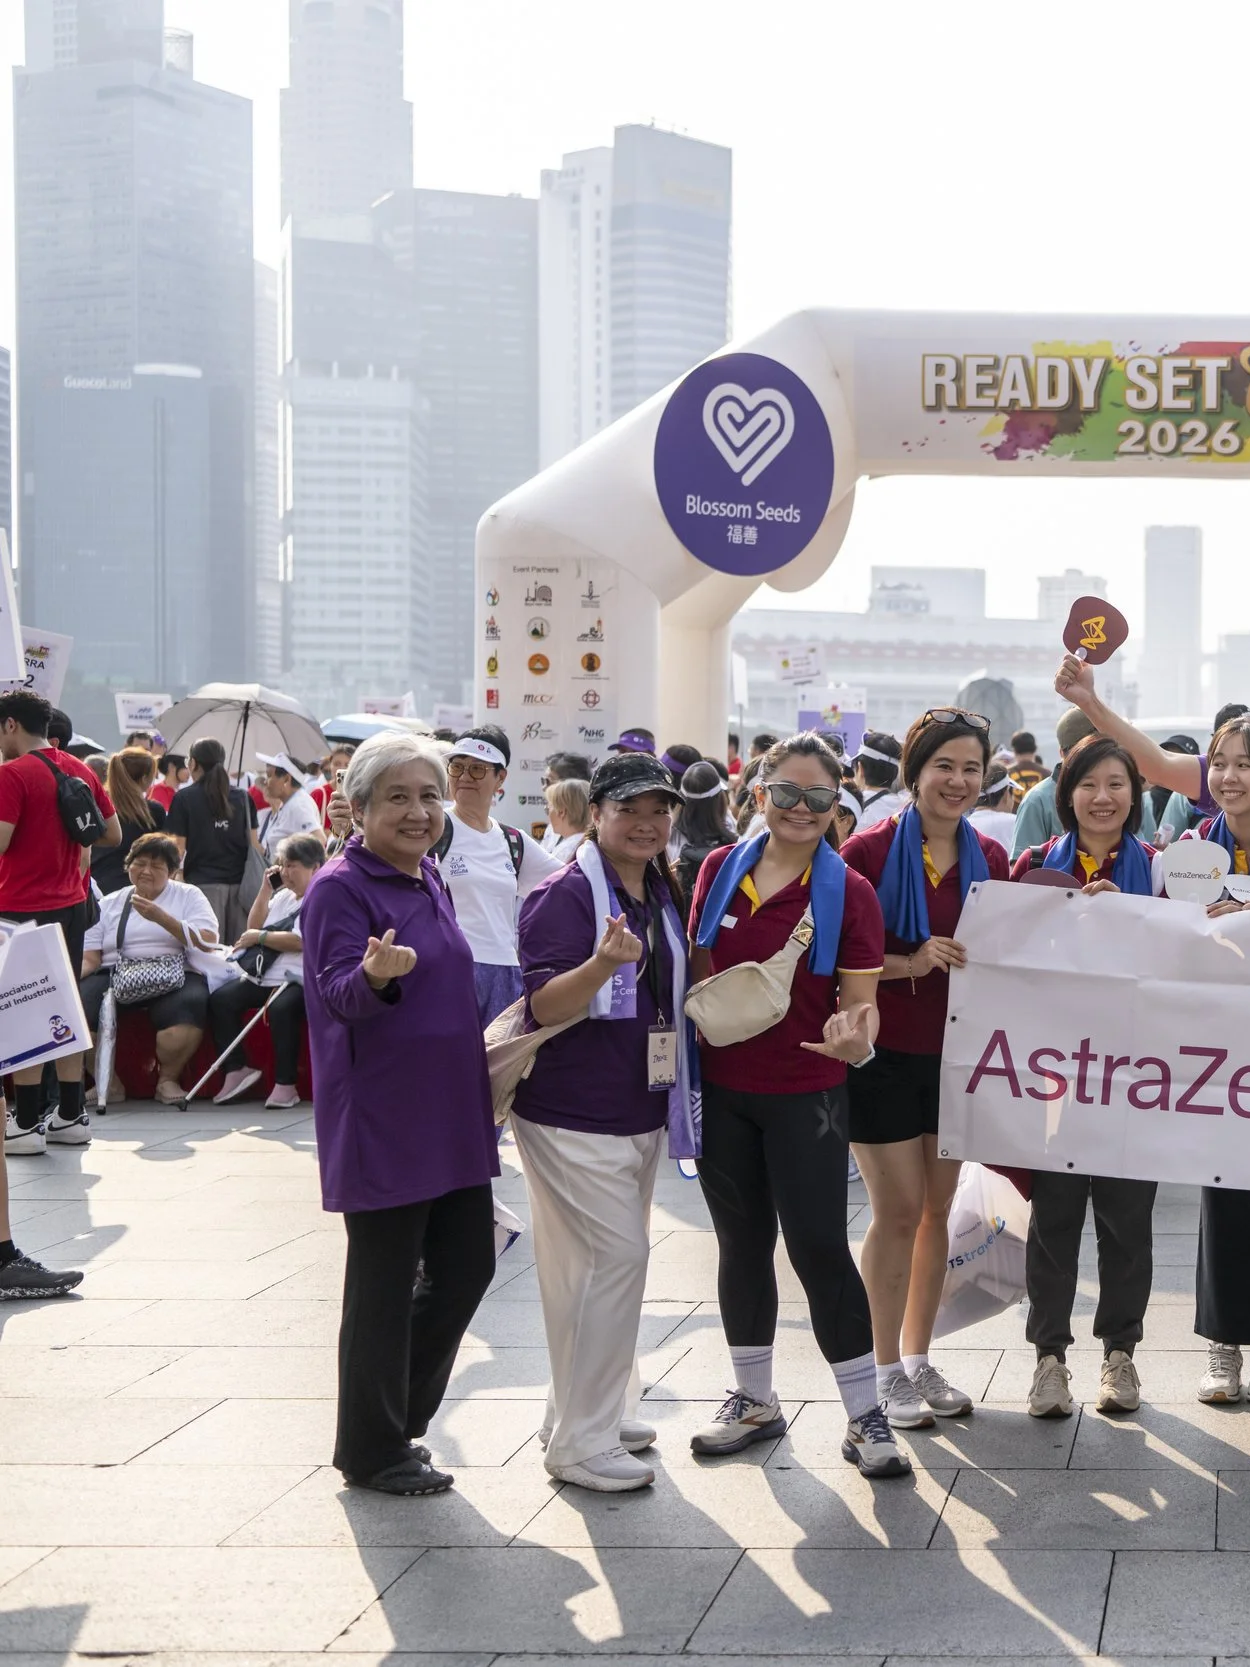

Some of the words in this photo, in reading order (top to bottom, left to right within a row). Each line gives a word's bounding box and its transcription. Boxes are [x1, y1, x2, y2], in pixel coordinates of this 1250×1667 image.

[922, 354, 1106, 412] READY
[1124, 354, 1231, 413] SET
[1116, 419, 1243, 456] 2026
[685, 494, 752, 519] Blossom
[755, 501, 801, 524] Seeds
[726, 524, 759, 545] 福善
[513, 565, 530, 573] Event
[531, 565, 559, 574] Partners
[584, 729, 605, 738] NHG
[1168, 871, 1212, 880] AstraZeneca
[40, 975, 49, 985] of
[13, 986, 57, 1006] Industries
